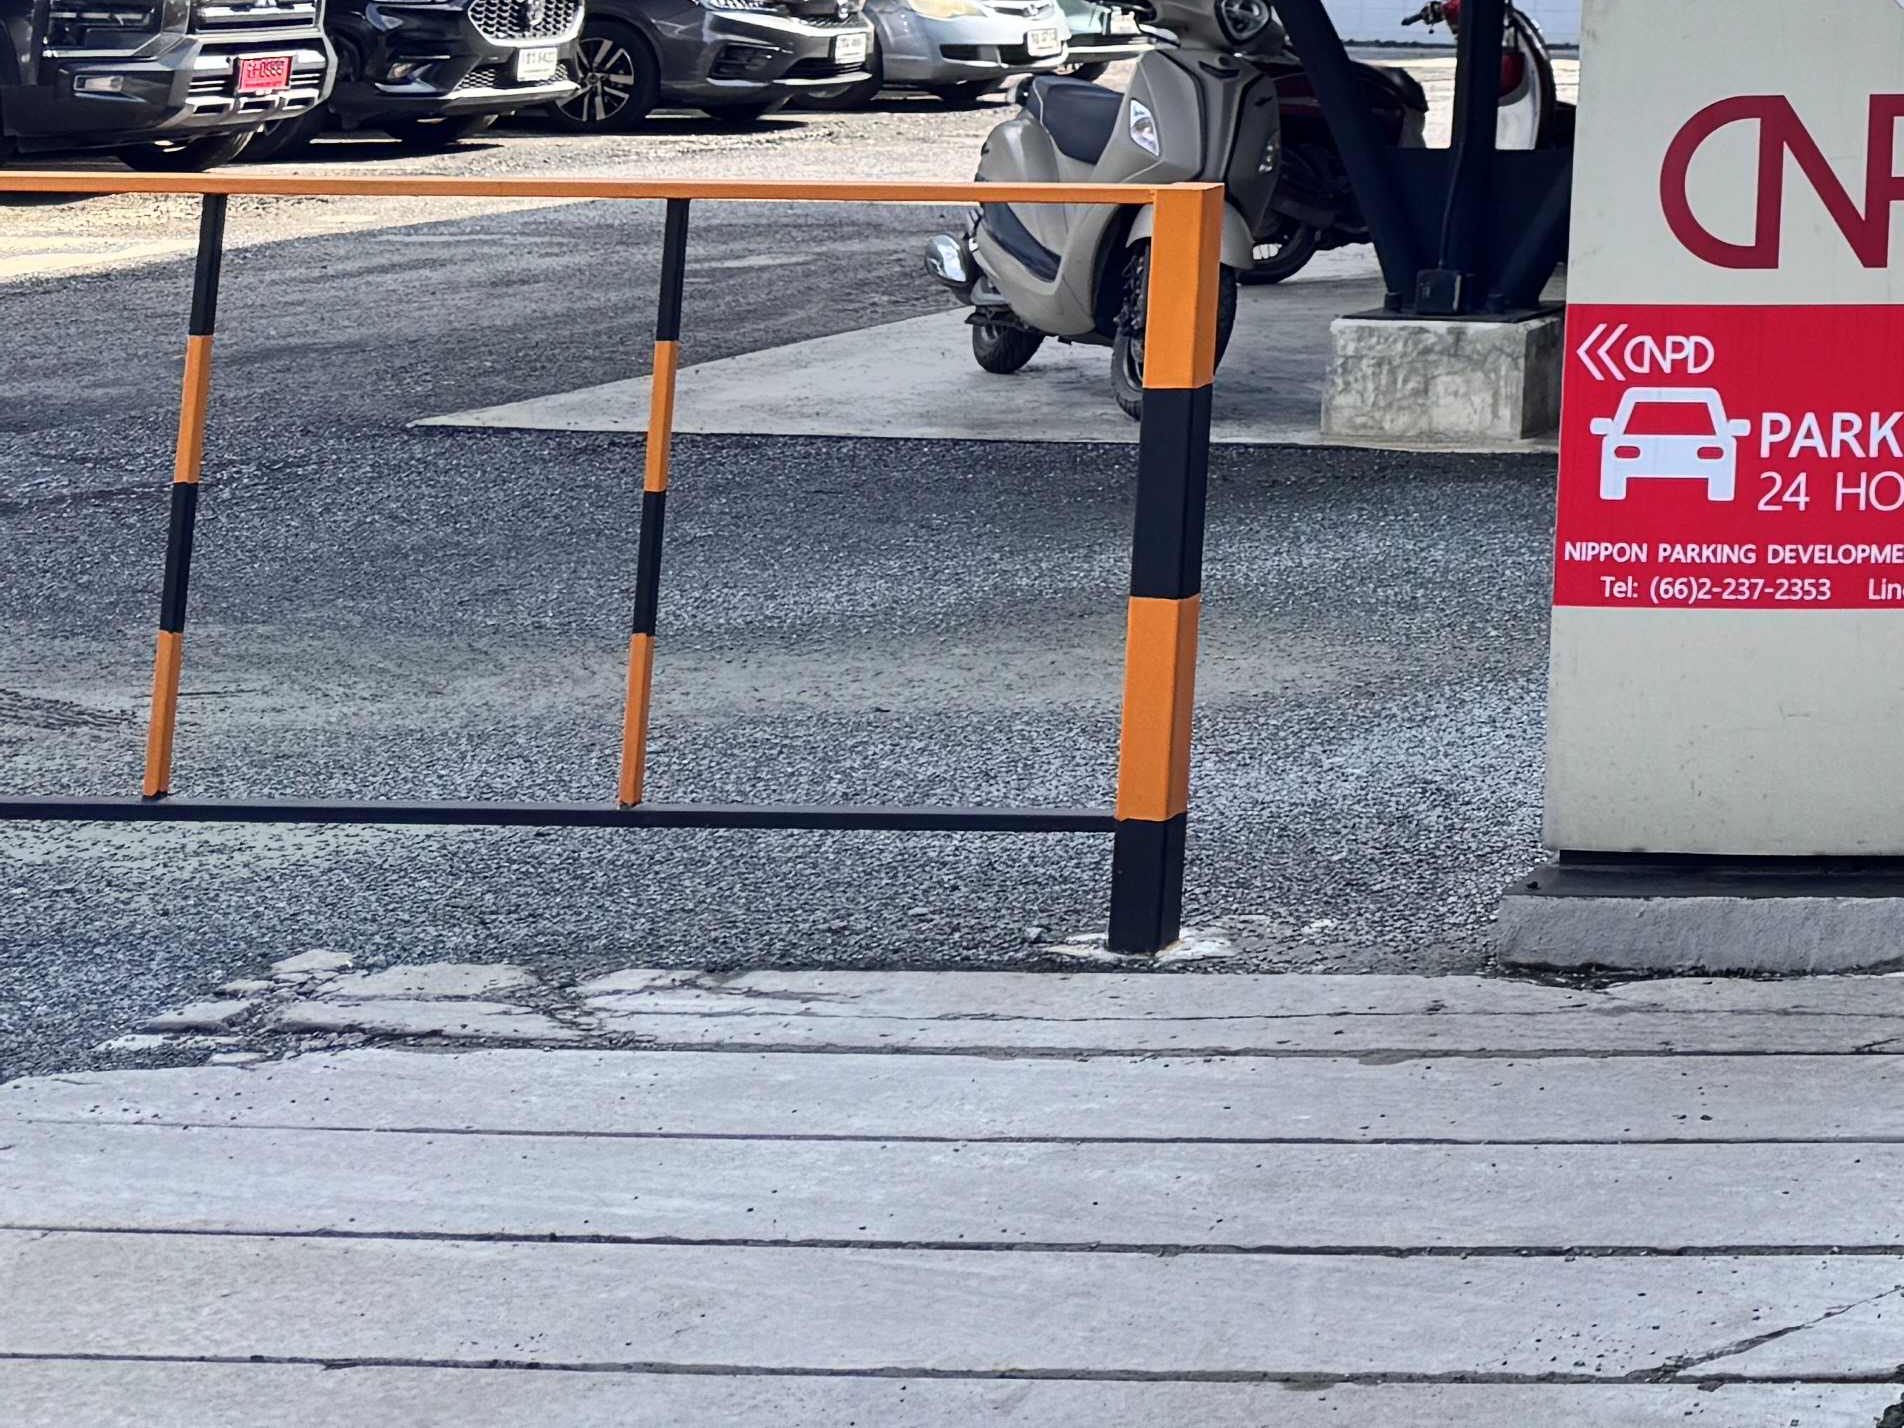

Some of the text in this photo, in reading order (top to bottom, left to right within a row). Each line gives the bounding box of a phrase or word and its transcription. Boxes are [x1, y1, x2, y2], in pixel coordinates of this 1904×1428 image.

[1757, 472, 1811, 512] 24
[1564, 541, 1648, 563] NIPPON
[1658, 542, 1757, 564] PARKING
[1600, 576, 1639, 599] Tel:
[1649, 575, 1831, 604] (66)2-237-2353
